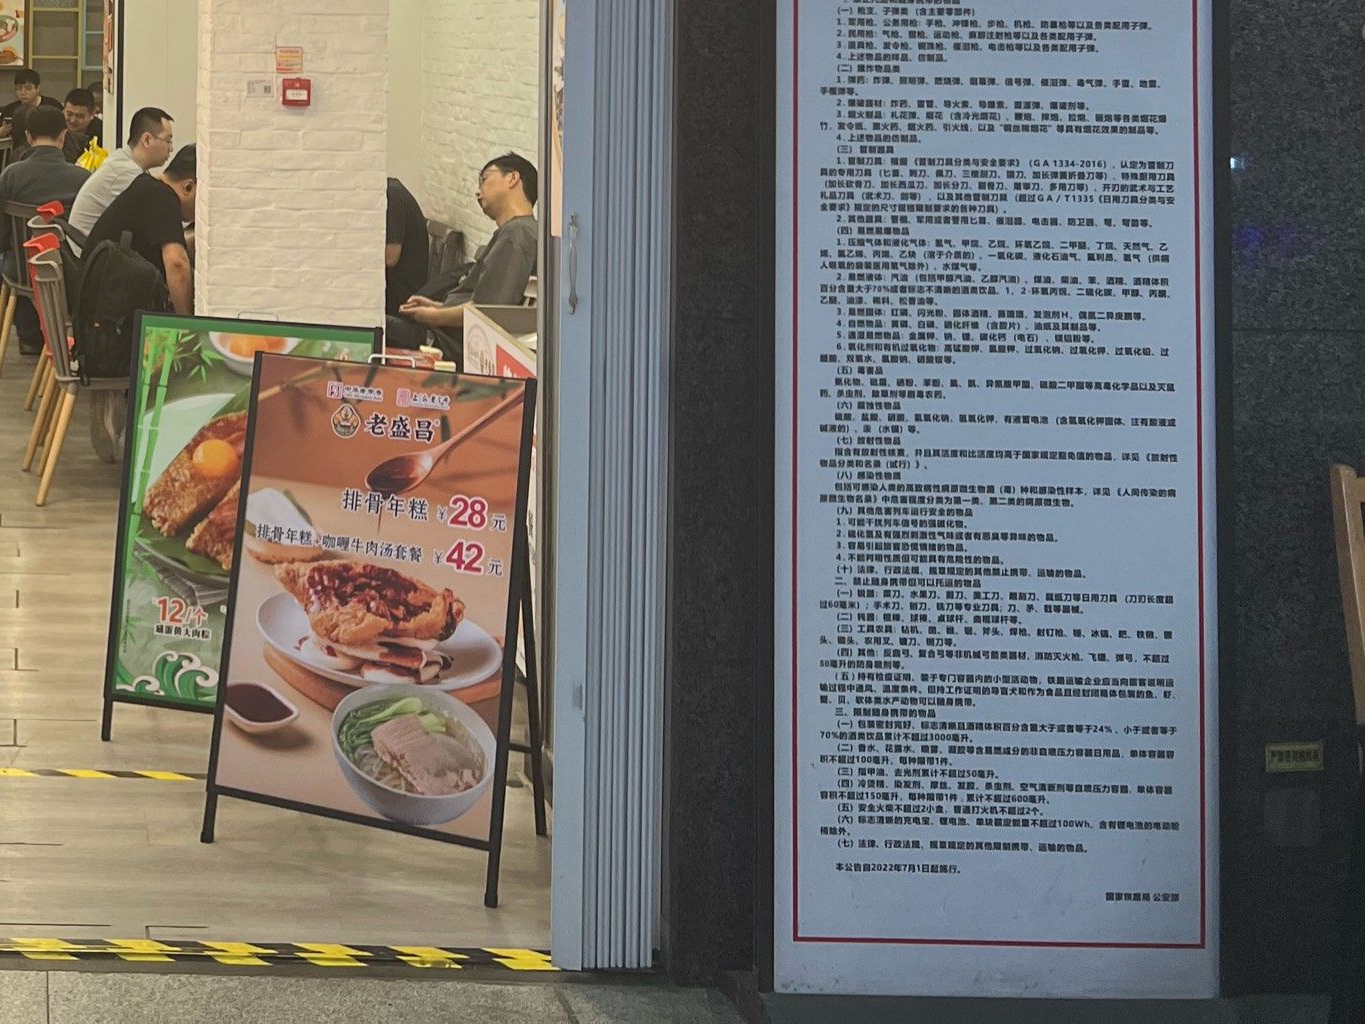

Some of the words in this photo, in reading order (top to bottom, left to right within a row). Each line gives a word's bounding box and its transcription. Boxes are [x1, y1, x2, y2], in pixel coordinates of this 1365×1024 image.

[366, 412, 435, 443] 老盛昌
[342, 488, 429, 521] 排骨年糕
